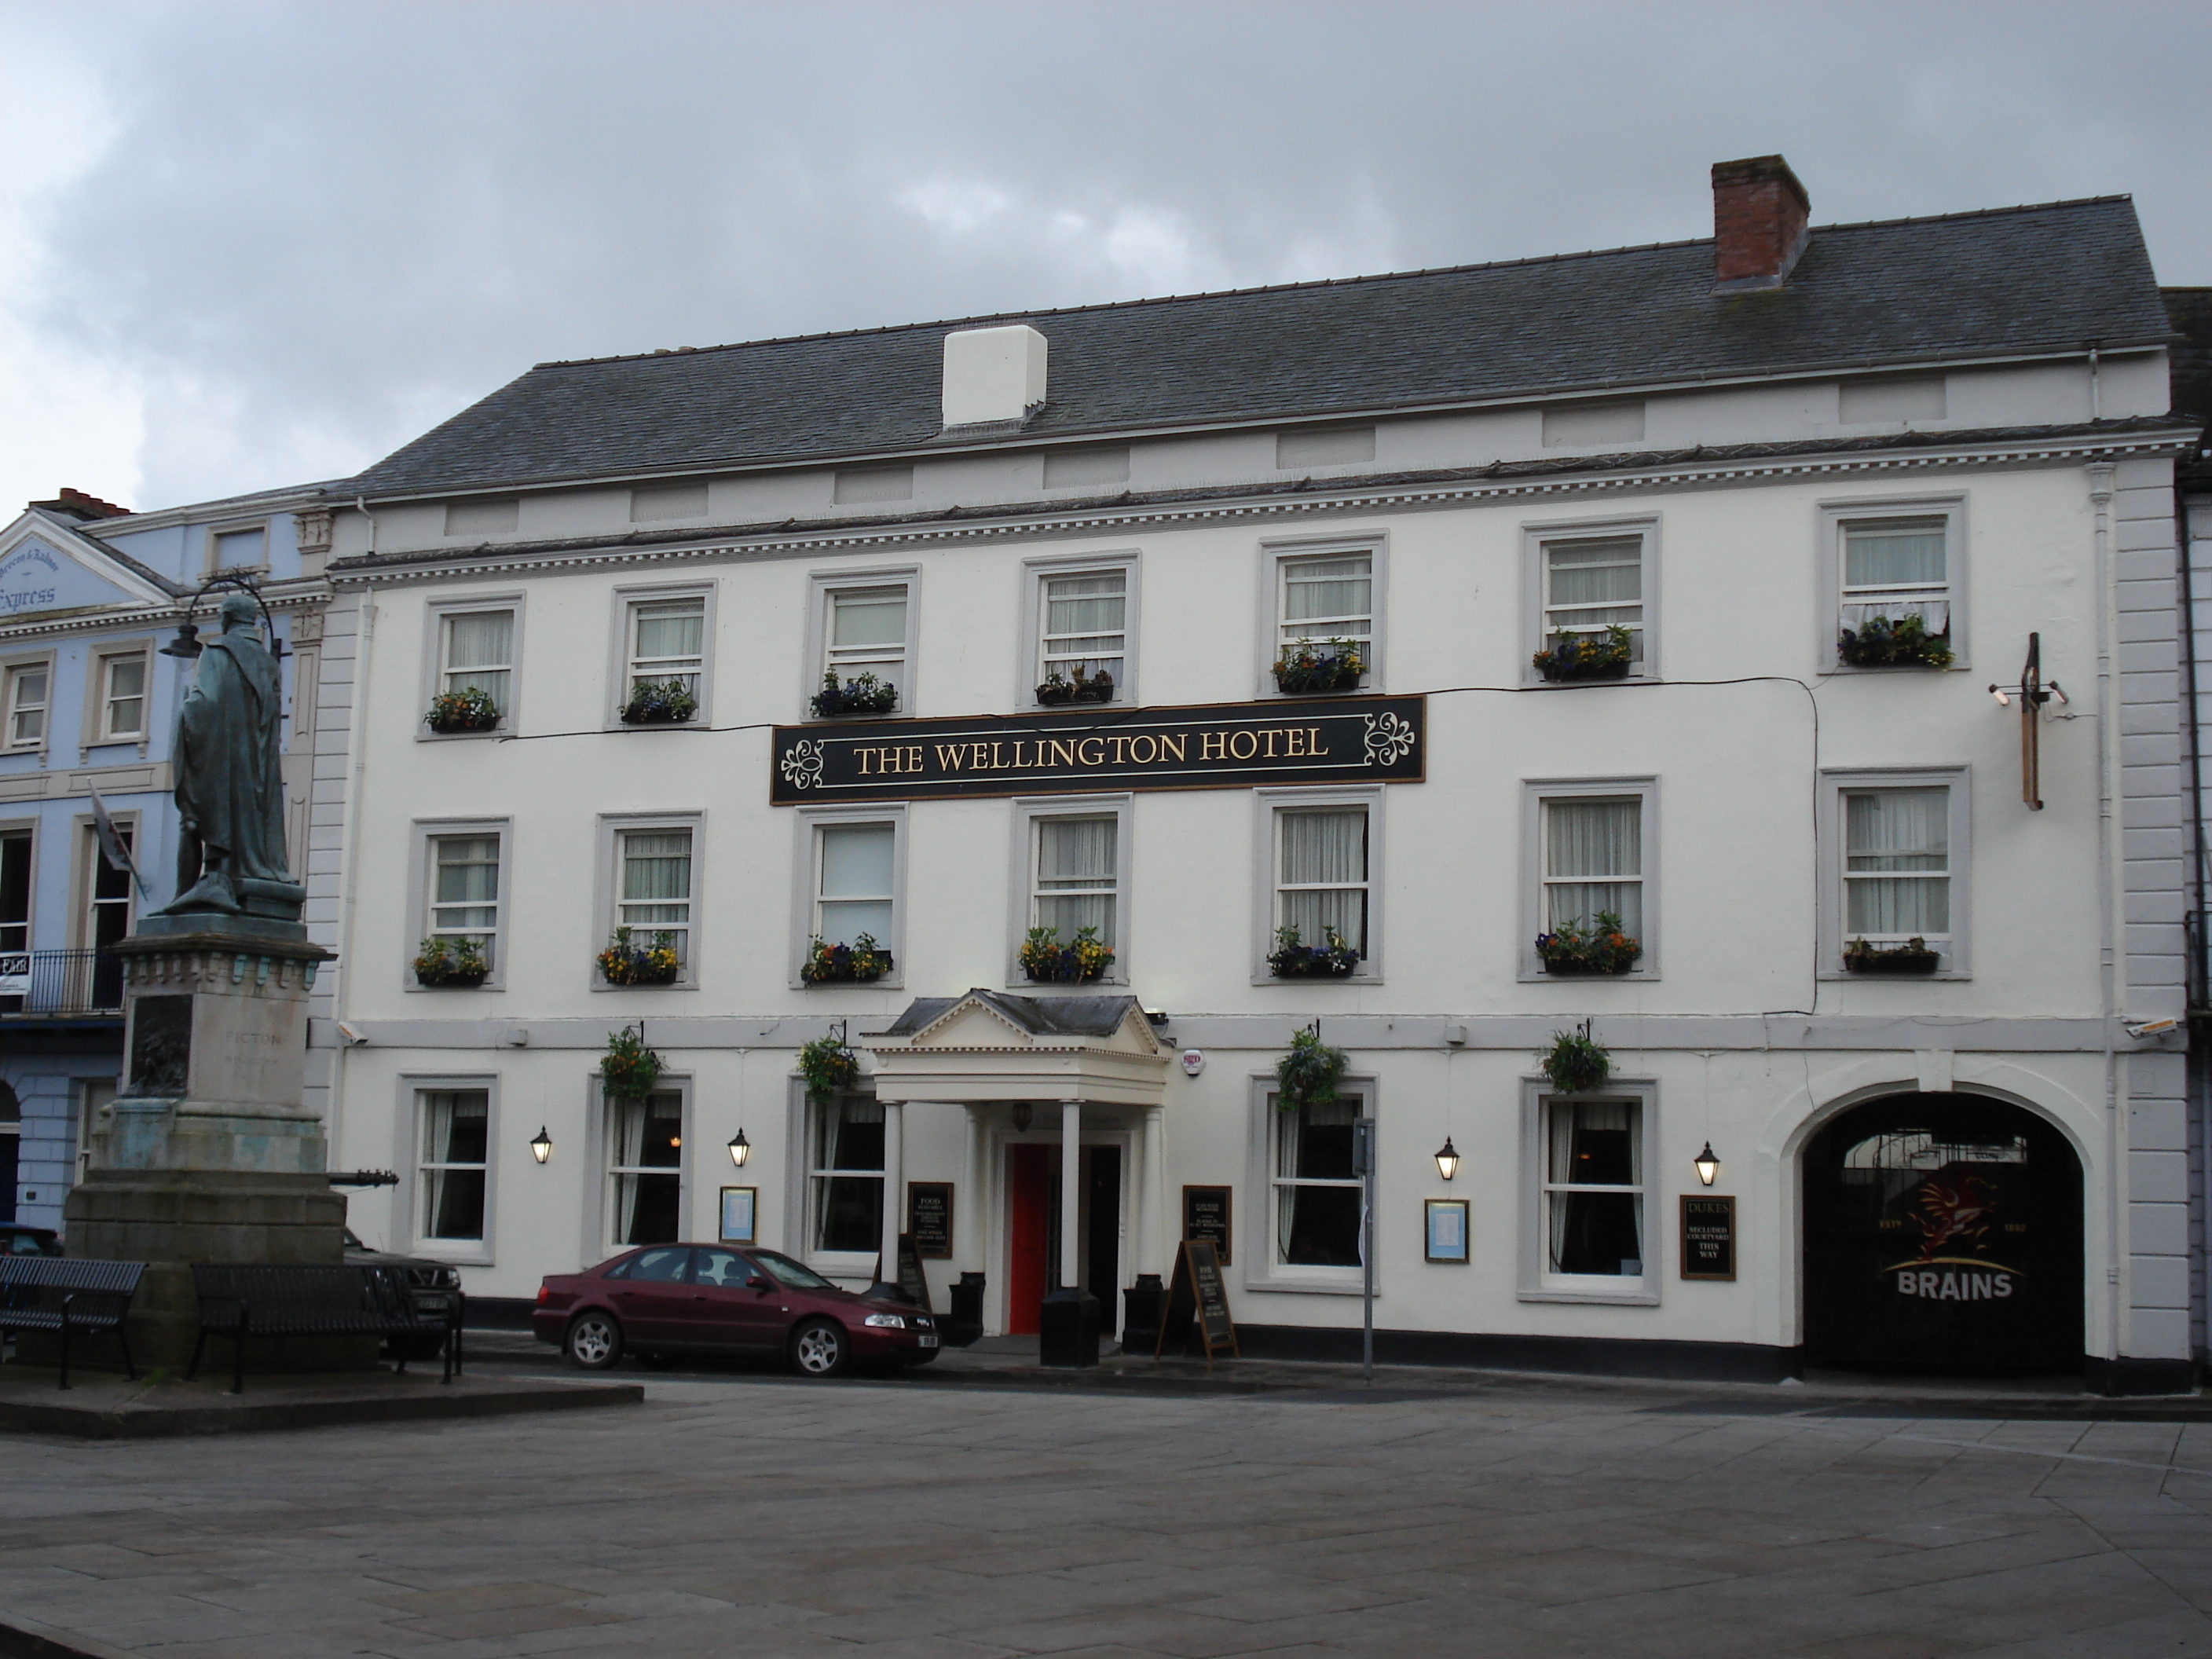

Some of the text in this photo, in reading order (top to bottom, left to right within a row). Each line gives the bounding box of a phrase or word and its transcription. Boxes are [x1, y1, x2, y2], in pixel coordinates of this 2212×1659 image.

[853, 727, 1329, 775] THE WELLINGTON HOTEL
[226, 1031, 281, 1046] PICTON
[1688, 1203, 1729, 1214] DUKES
[1698, 1242, 1719, 1251] THIS
[1898, 1271, 2013, 1301] BRAINS
